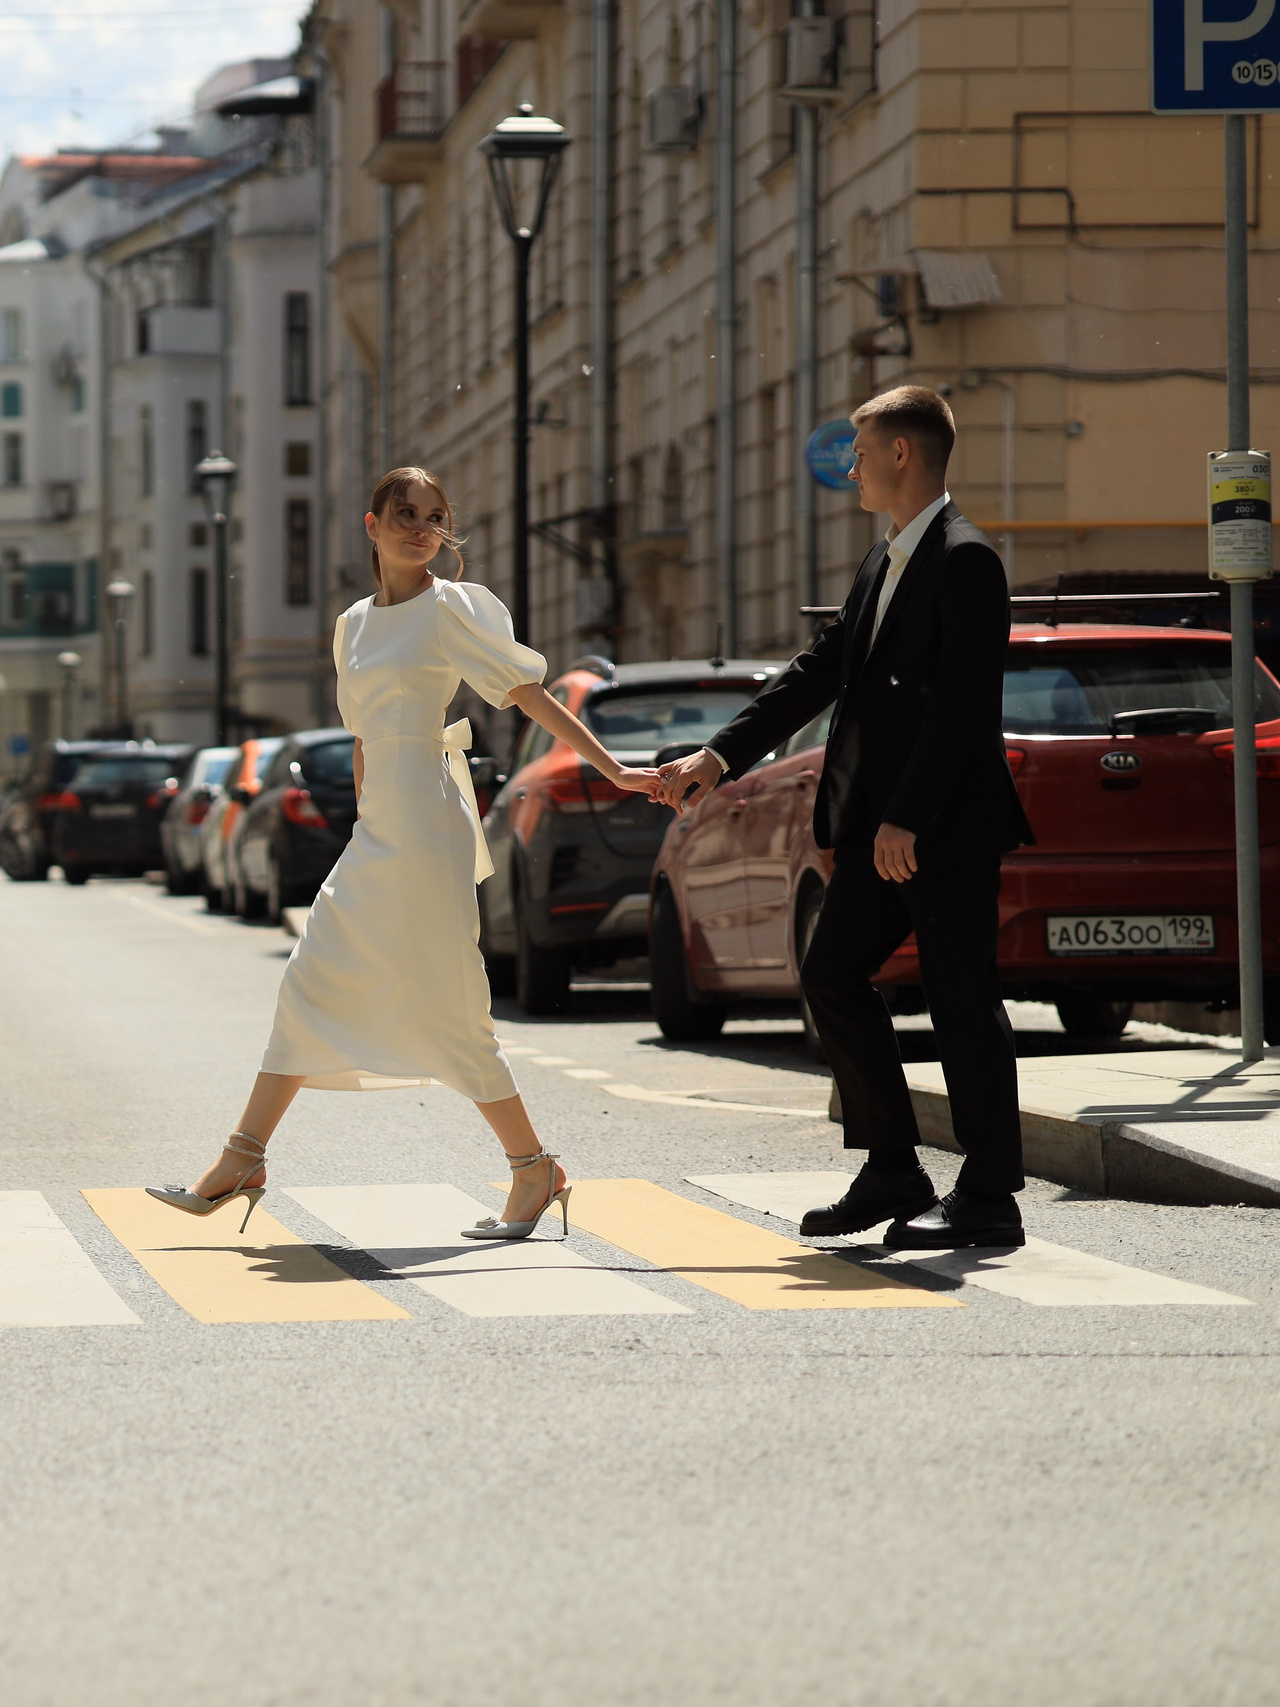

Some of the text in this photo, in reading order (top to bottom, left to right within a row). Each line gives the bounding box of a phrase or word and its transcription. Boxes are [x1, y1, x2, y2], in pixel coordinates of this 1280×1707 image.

[1184, 0, 1276, 91] P
[1236, 64, 1273, 80] 10 15
[1107, 755, 1136, 768] KIA
[1167, 917, 1205, 937] 199
